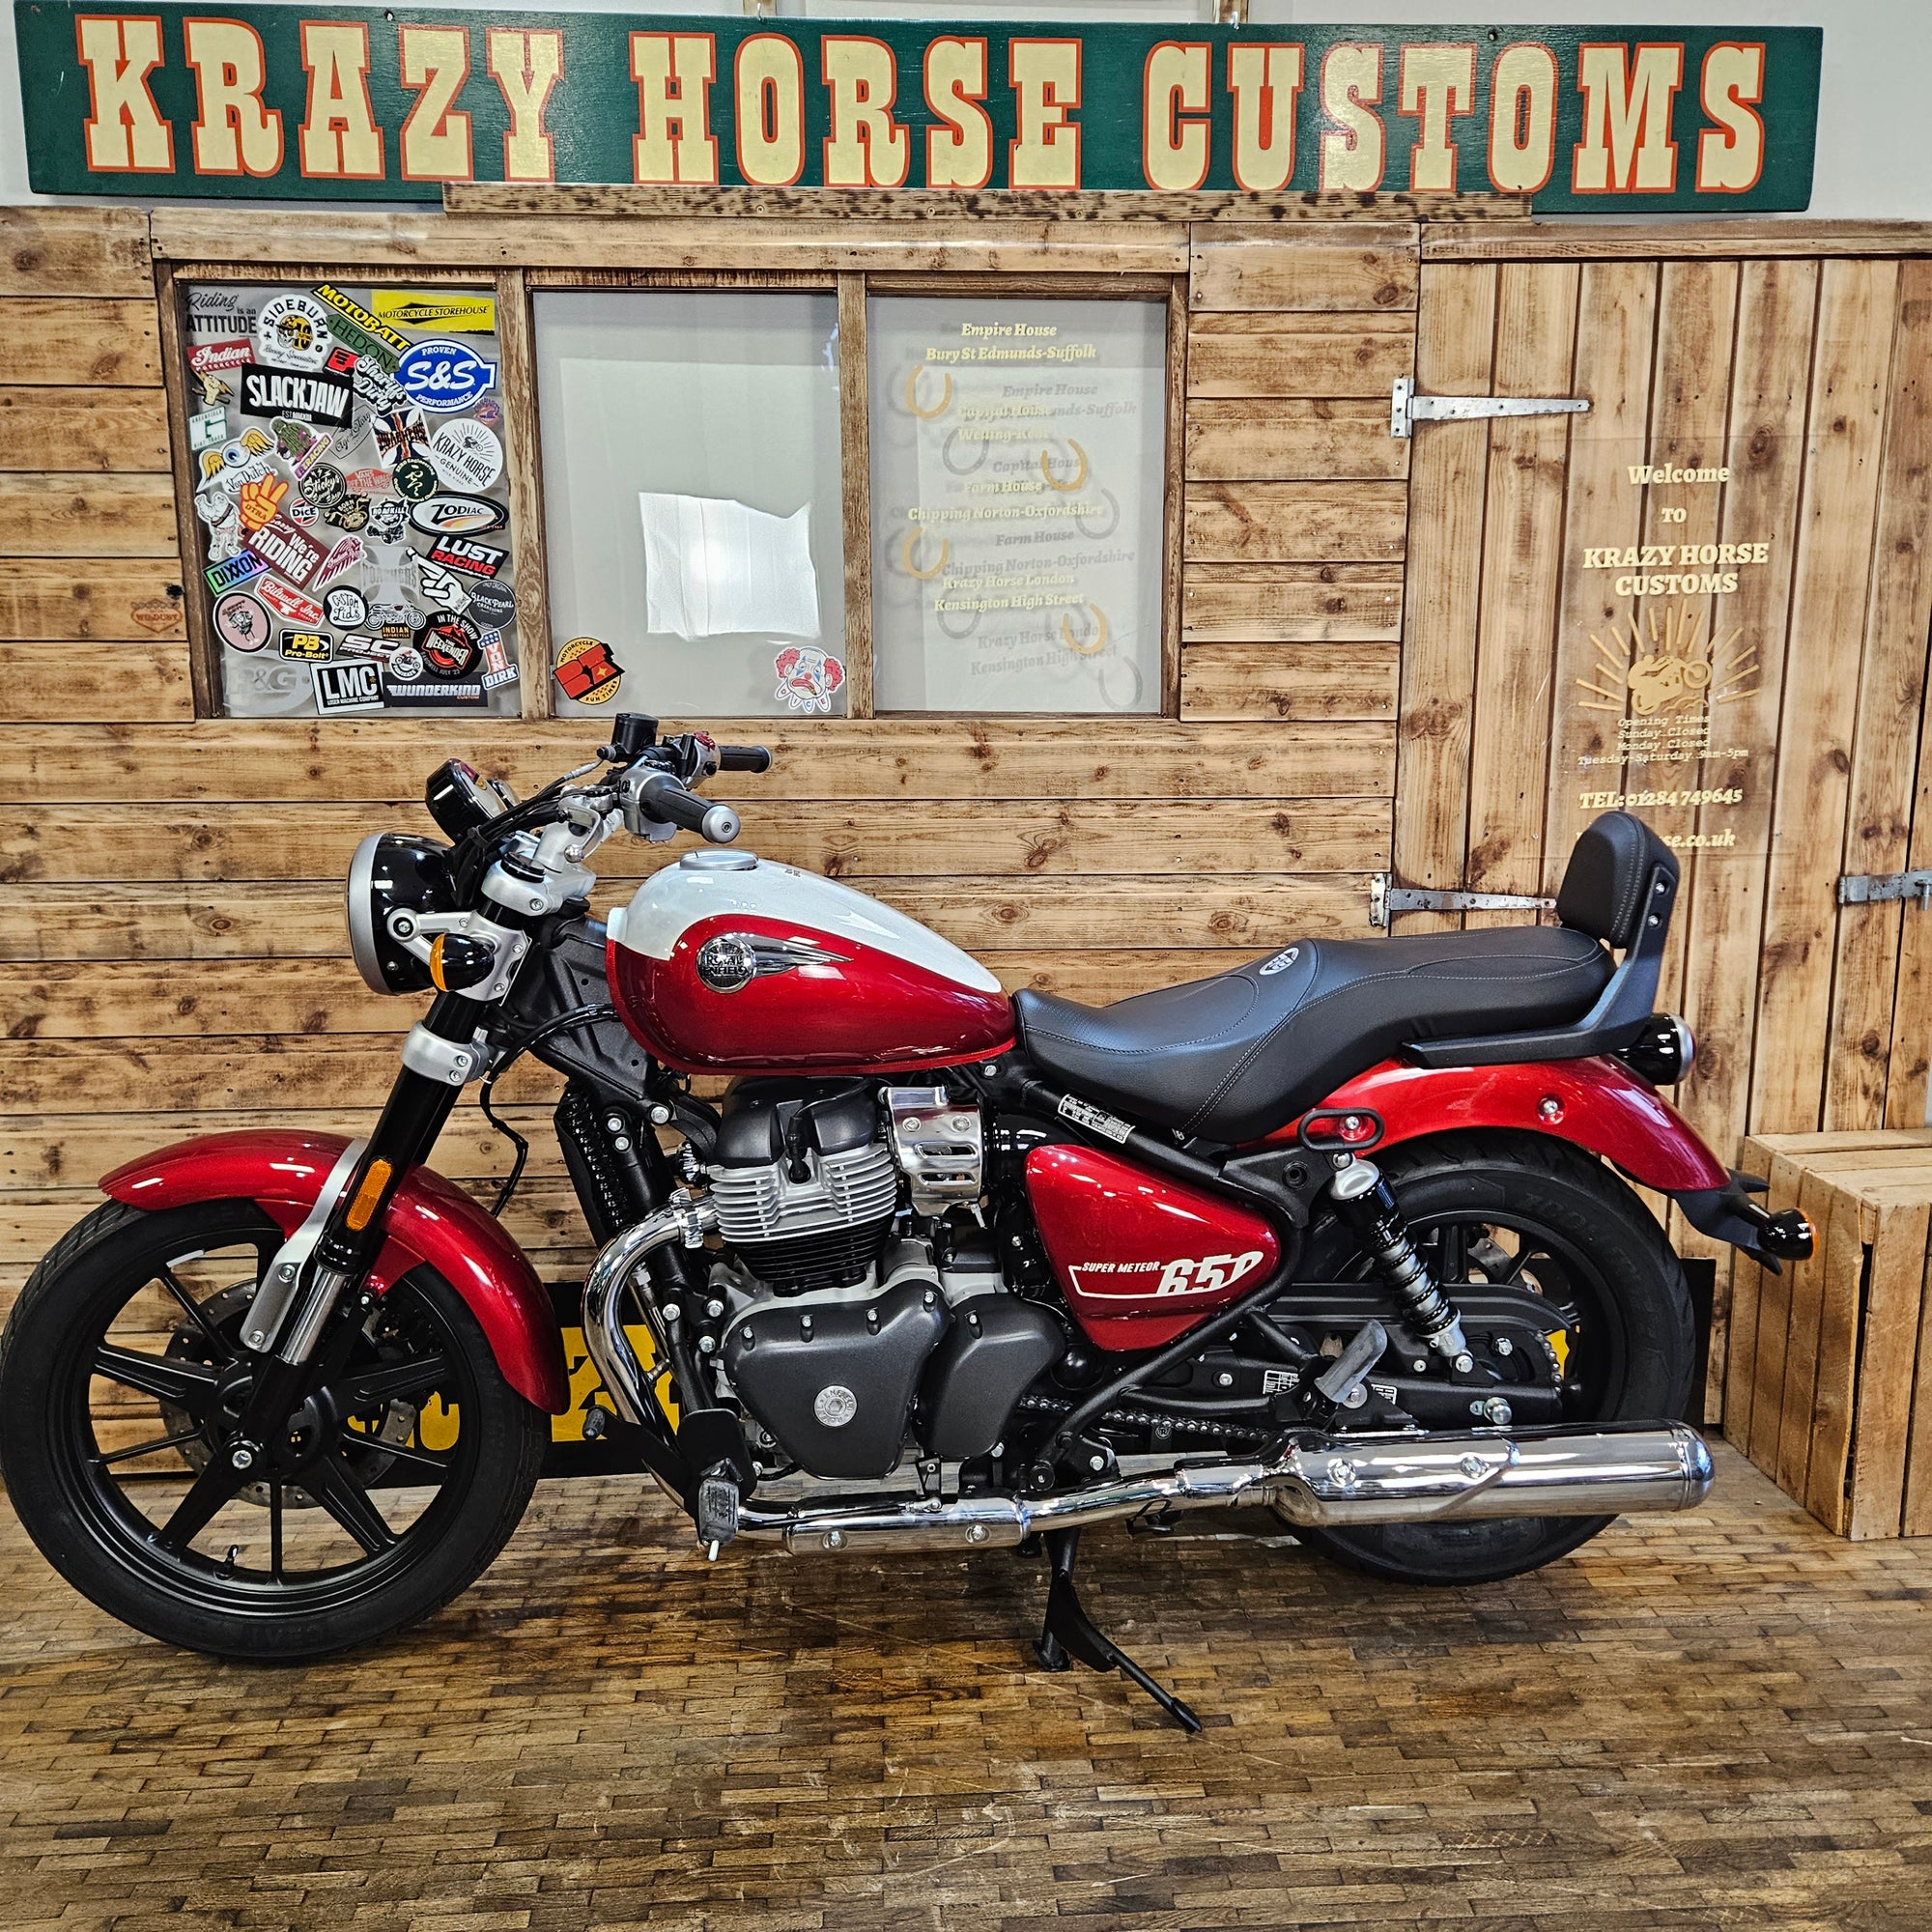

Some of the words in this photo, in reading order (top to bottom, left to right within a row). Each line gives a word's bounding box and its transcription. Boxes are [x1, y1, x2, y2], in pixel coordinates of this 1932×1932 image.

[75, 14, 564, 182] KRAZY
[629, 32, 1082, 188] HORSE
[1143, 42, 1766, 193] CUSTOMS
[186, 292, 239, 311] Riding
[378, 308, 433, 319] MOTORCYCLE
[434, 305, 488, 316] STOREHOUSE
[185, 314, 257, 333] ATTITUDE
[263, 298, 328, 340] SIDEBURN
[317, 284, 412, 351] MOTOBATT
[961, 323, 1012, 339] Empire
[1013, 323, 1057, 336] House
[332, 319, 393, 368] HEDON
[421, 346, 458, 356] PROVEN
[925, 347, 962, 363] Bury
[962, 347, 977, 360] St
[978, 345, 1096, 362] Edmunds-Suffolk
[191, 346, 251, 366] Indian
[195, 358, 251, 371] MOTORCYCLE
[404, 360, 478, 390] S&S
[245, 375, 350, 418] SLACKJAW
[415, 391, 473, 407] PERFORMANCE
[433, 432, 467, 462] KRAZY
[463, 455, 497, 487] HORSE
[241, 462, 271, 483] Dutch
[440, 458, 472, 484] GENUINE
[1628, 463, 1730, 485] Welcome
[964, 481, 999, 494] Farm
[1001, 480, 1042, 493] House
[244, 503, 268, 521] DTRA
[338, 499, 355, 511] BORN
[430, 503, 484, 525] ZODIAC
[908, 506, 971, 523] Chipping
[972, 503, 1105, 520] Norton-Oxfordshire
[1662, 507, 1688, 524] TO
[248, 526, 313, 582] RIDING
[436, 535, 503, 565] LUST
[1583, 545, 1677, 569] KRAZY
[1679, 542, 1770, 566] HORSE
[211, 554, 263, 588] DIXXON
[431, 550, 497, 576] RACING
[942, 575, 983, 591] Krazy
[983, 574, 1024, 588] Horse
[1026, 572, 1075, 586] London
[1615, 572, 1739, 596] CUSTOMS
[934, 597, 1009, 613] Kensington
[1010, 594, 1042, 609] High
[1044, 592, 1085, 606] Street
[437, 614, 446, 624] IN
[446, 613, 461, 626] THE
[459, 619, 479, 640] SHOW
[292, 634, 321, 651] PB
[342, 635, 400, 653] SC
[425, 631, 469, 667] WEEKENDER
[560, 639, 594, 663] MOTORCYCLE
[486, 642, 504, 672] VON
[322, 667, 379, 700] LMC
[485, 666, 517, 688] DIRK
[386, 684, 481, 696] WUNDERKIND
[602, 680, 618, 698] TIMES
[1617, 717, 1669, 728] Opening
[1675, 714, 1711, 724] Times
[1680, 787, 1744, 806] 749645
[706, 954, 744, 966] ROYAL
[705, 966, 748, 977] ENFIELD
[1081, 1261, 1115, 1273] SUPER
[1117, 1260, 1160, 1273] METEOR
[1156, 1251, 1264, 1296] 650
